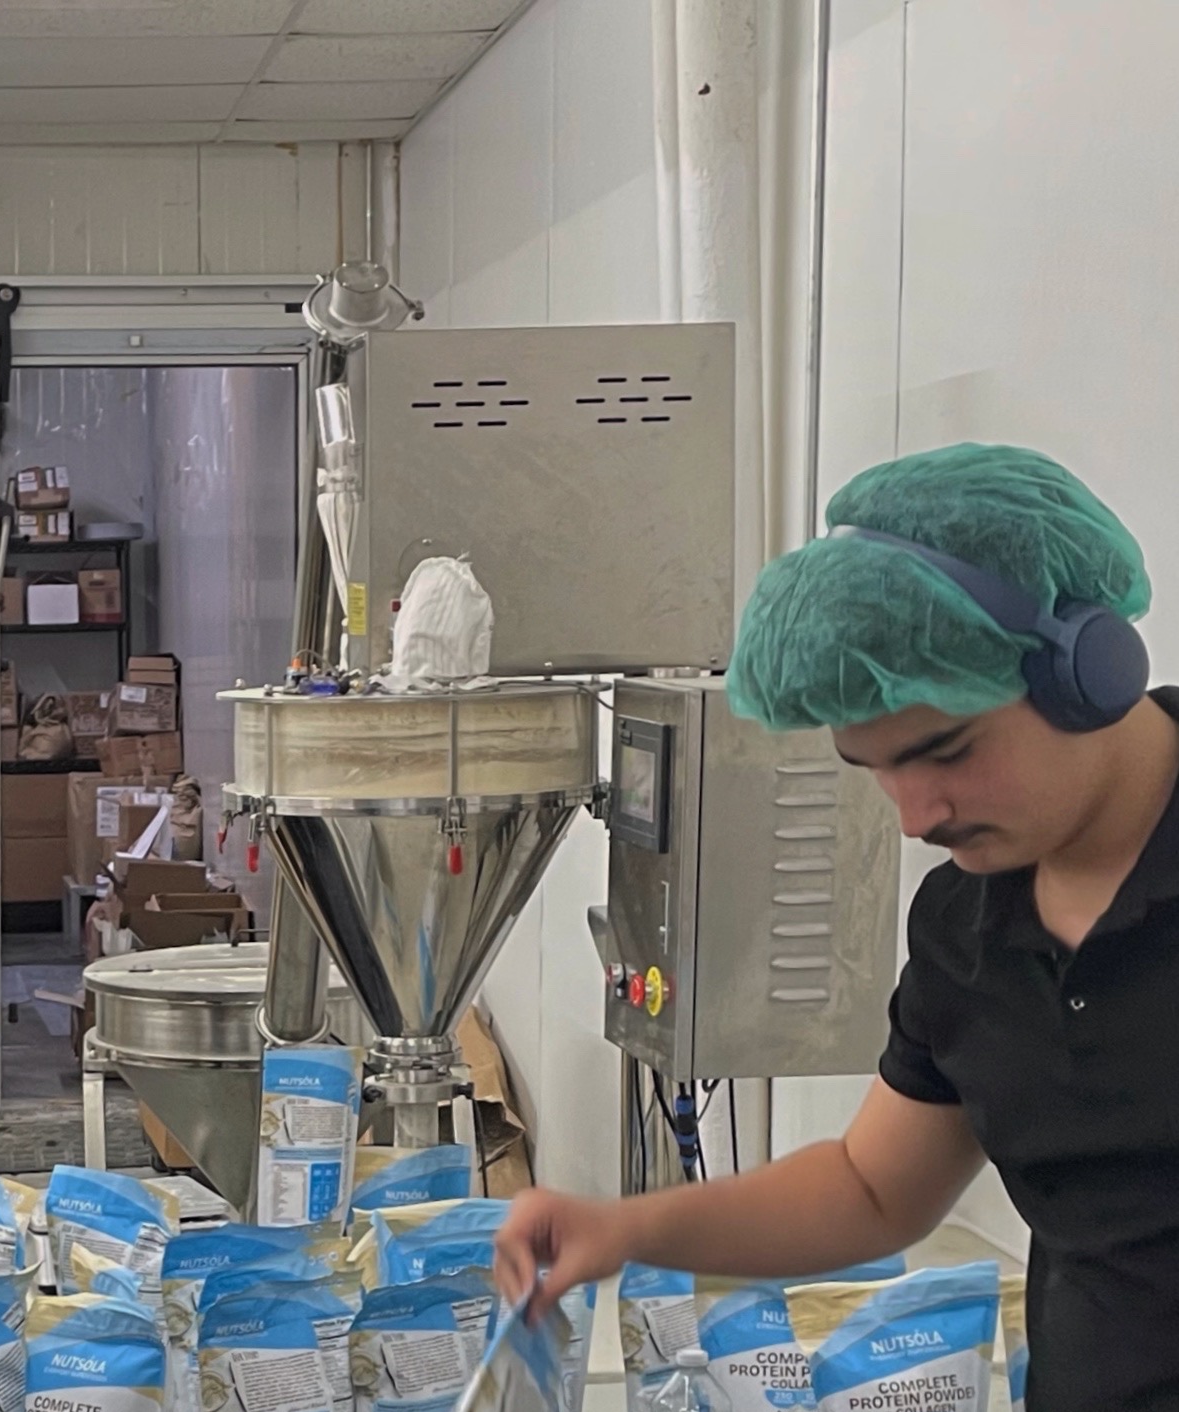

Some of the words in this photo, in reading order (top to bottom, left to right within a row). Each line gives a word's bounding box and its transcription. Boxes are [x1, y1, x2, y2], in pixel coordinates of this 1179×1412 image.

[729, 1363, 797, 1378] PROTEIN
[878, 1374, 958, 1395] COMPLETE
[849, 1392, 921, 1411] PROTEIN
